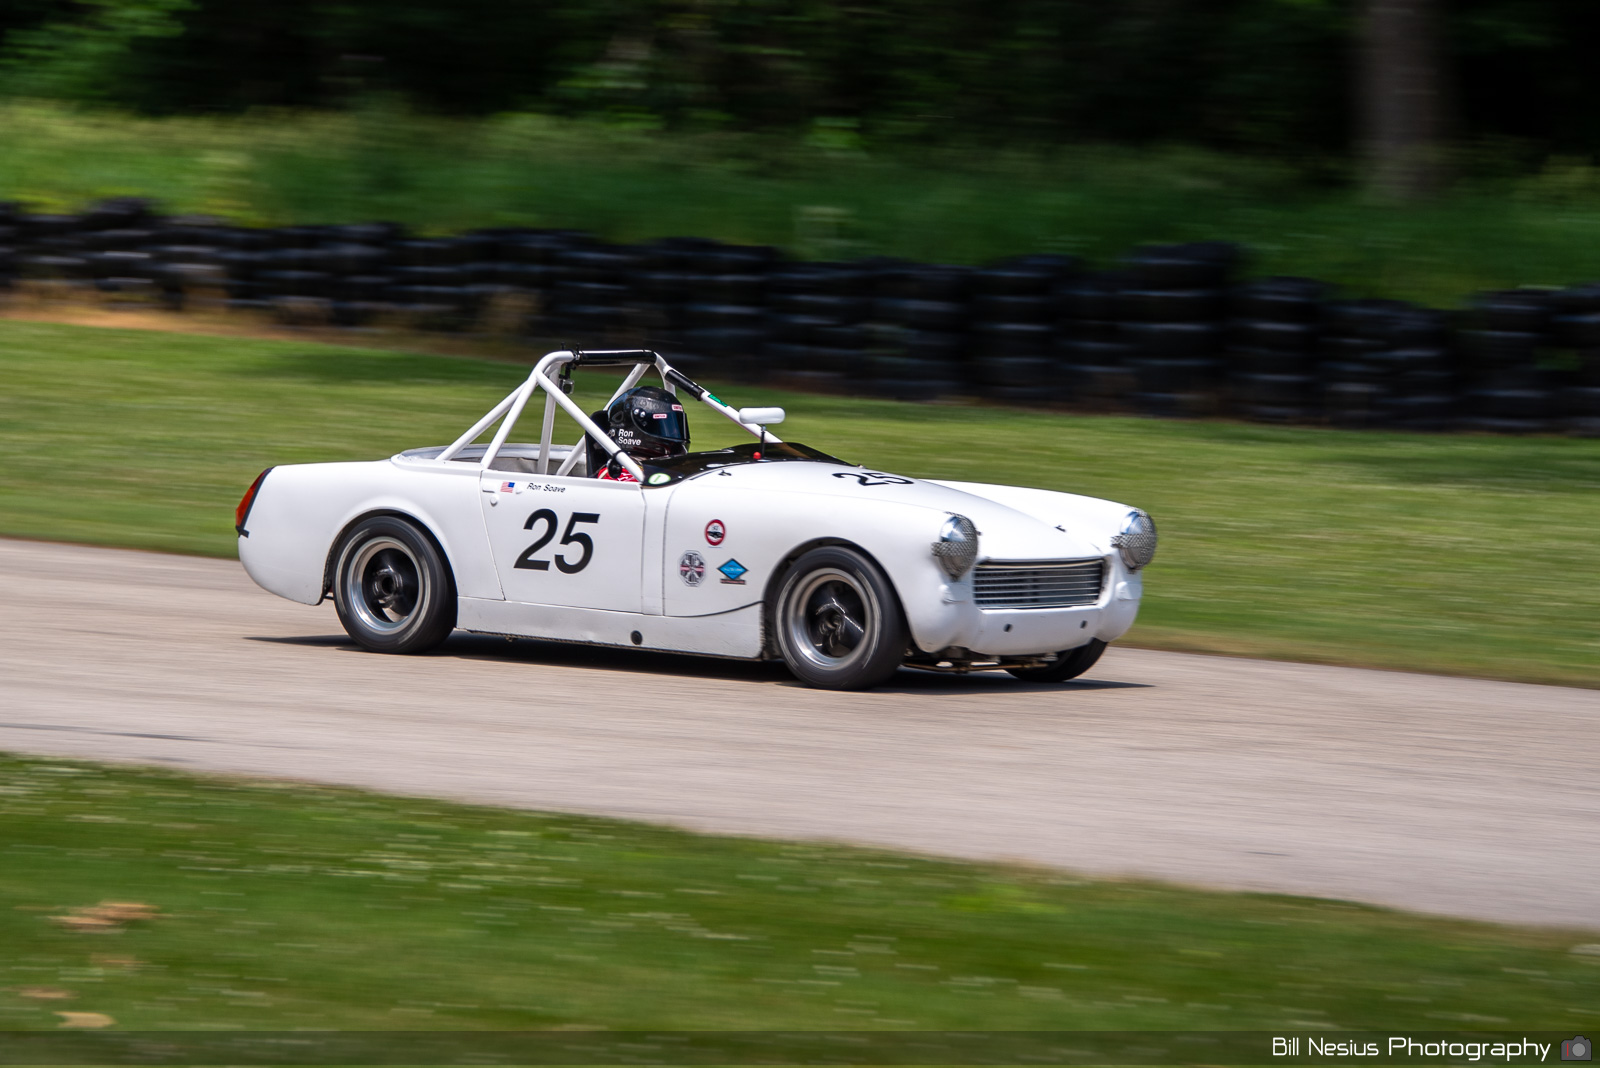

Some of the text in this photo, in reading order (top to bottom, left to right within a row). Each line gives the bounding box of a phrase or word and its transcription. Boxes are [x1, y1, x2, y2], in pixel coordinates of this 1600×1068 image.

[618, 428, 634, 437] Ron
[618, 436, 642, 446] Soave
[831, 472, 914, 486] 25
[526, 482, 566, 493] Ron Soave
[513, 508, 600, 575] 25
